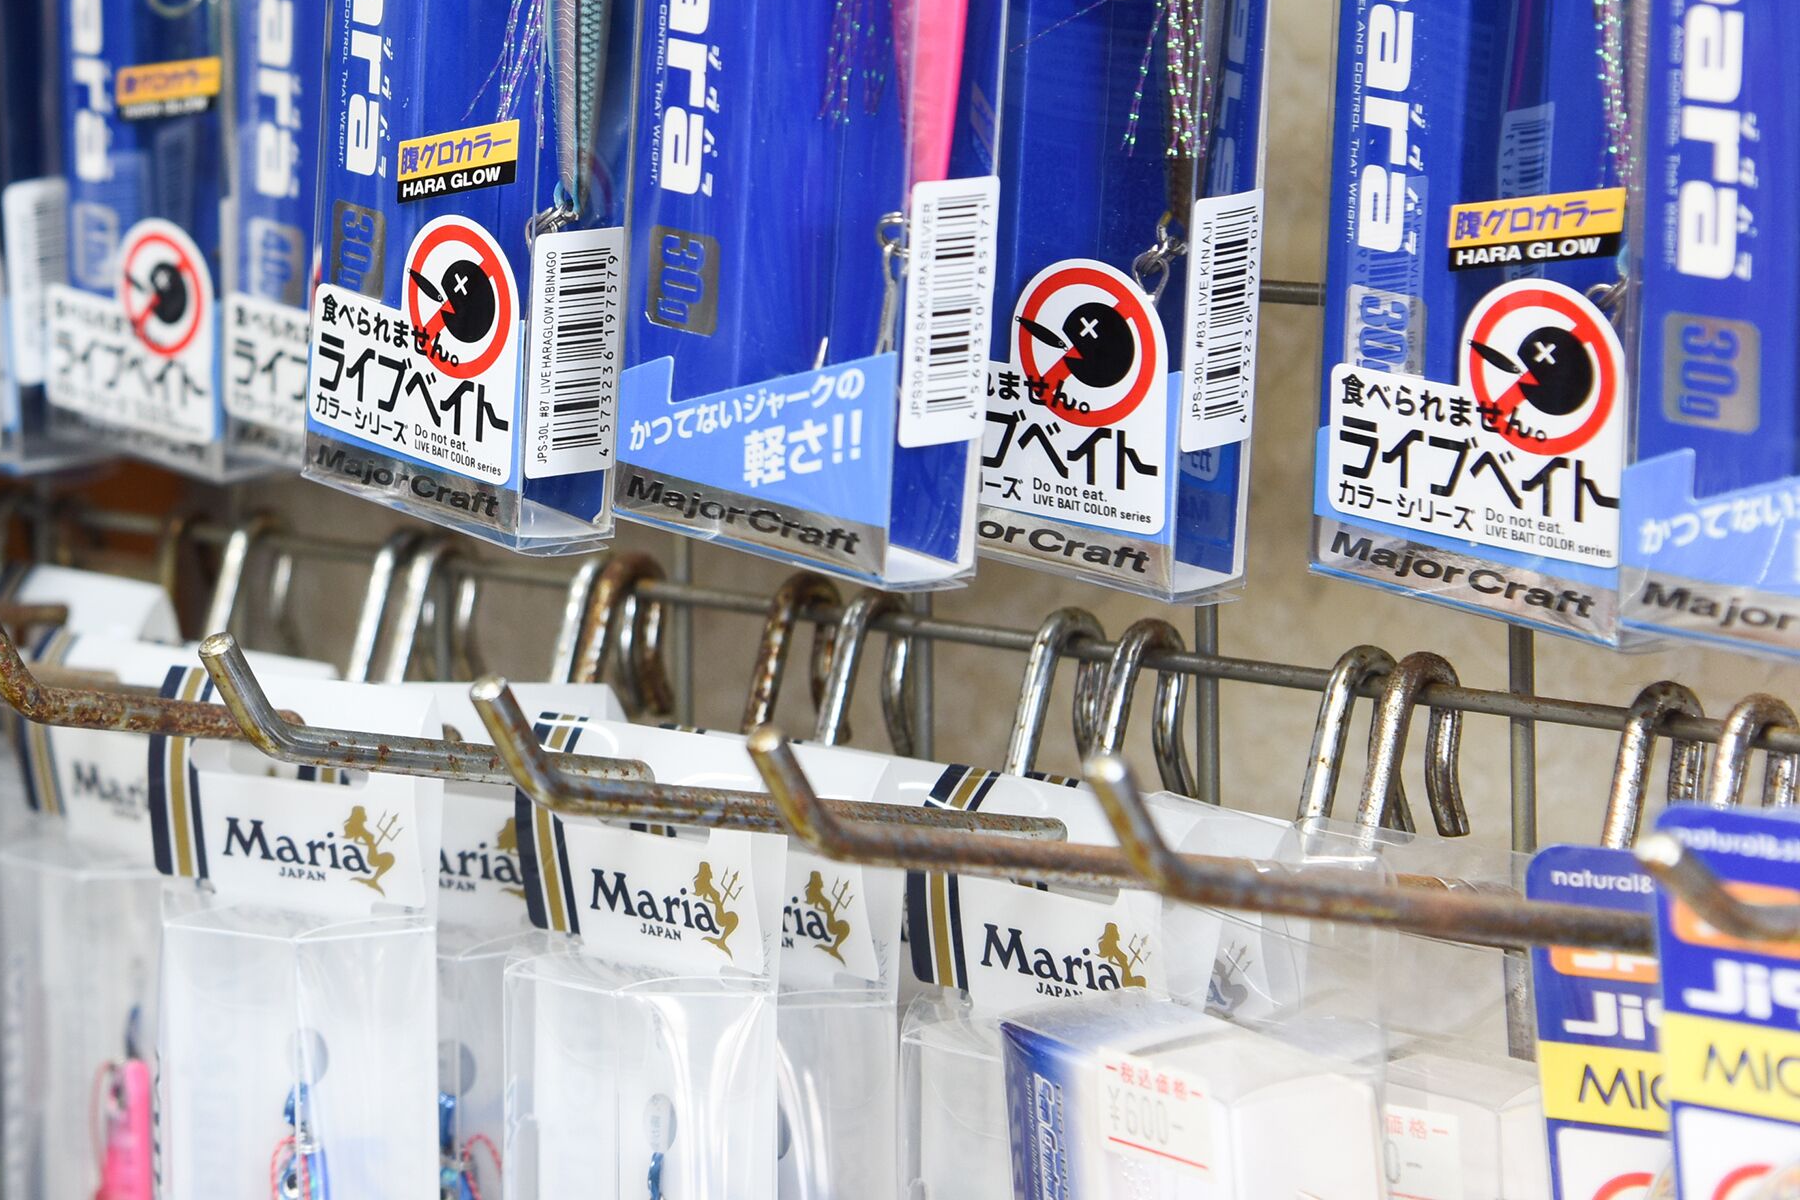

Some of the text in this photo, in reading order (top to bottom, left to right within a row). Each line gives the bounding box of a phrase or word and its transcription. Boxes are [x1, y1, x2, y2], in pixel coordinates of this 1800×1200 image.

[400, 132, 513, 175] 腹グロカラー
[402, 166, 502, 198] HARA GLOW
[1203, 220, 1213, 245] AJI
[1455, 202, 1617, 240] 腹グロカラー
[1200, 250, 1211, 276] KIN
[1456, 238, 1601, 267] HARA GLOW
[1198, 280, 1209, 317] LIVE
[321, 293, 460, 368] 食べられません。
[536, 251, 558, 464] JPS-30L #87 LIVE HARAGLOW KIBINAGO
[318, 332, 509, 444] ライブベイト
[628, 368, 866, 452] かつてないジャークの
[1192, 357, 1205, 421] JPS-30L
[1341, 373, 1547, 443] 食べられません。
[316, 392, 408, 446] カラーシリーズ
[414, 423, 469, 453] Do not eat.
[414, 438, 502, 477] LIVE BAIT COLOR series
[980, 410, 1158, 490] ブベイト
[1338, 416, 1619, 523] ライブベイト
[318, 445, 499, 518] Major Craft
[1032, 477, 1052, 493] Do
[1055, 482, 1078, 498] not
[1081, 487, 1108, 503] eat.
[1338, 480, 1475, 531] カラーシリーズ
[627, 475, 861, 556] Major Craft
[1032, 492, 1152, 524] LIVE BAIT COLOR series
[1485, 507, 1565, 536] Do not eat.
[1638, 483, 1800, 555] かつてない
[1029, 528, 1150, 574] Craft
[1485, 523, 1612, 559] LIVE BAIT COLOR series
[1330, 530, 1595, 619] Major Craft
[222, 817, 373, 875] Maria
[278, 865, 327, 883] JAPAN
[1550, 869, 1655, 894] natural&
[589, 868, 721, 935] Maria
[639, 921, 683, 942] JAPAN
[980, 922, 1121, 993] Maria
